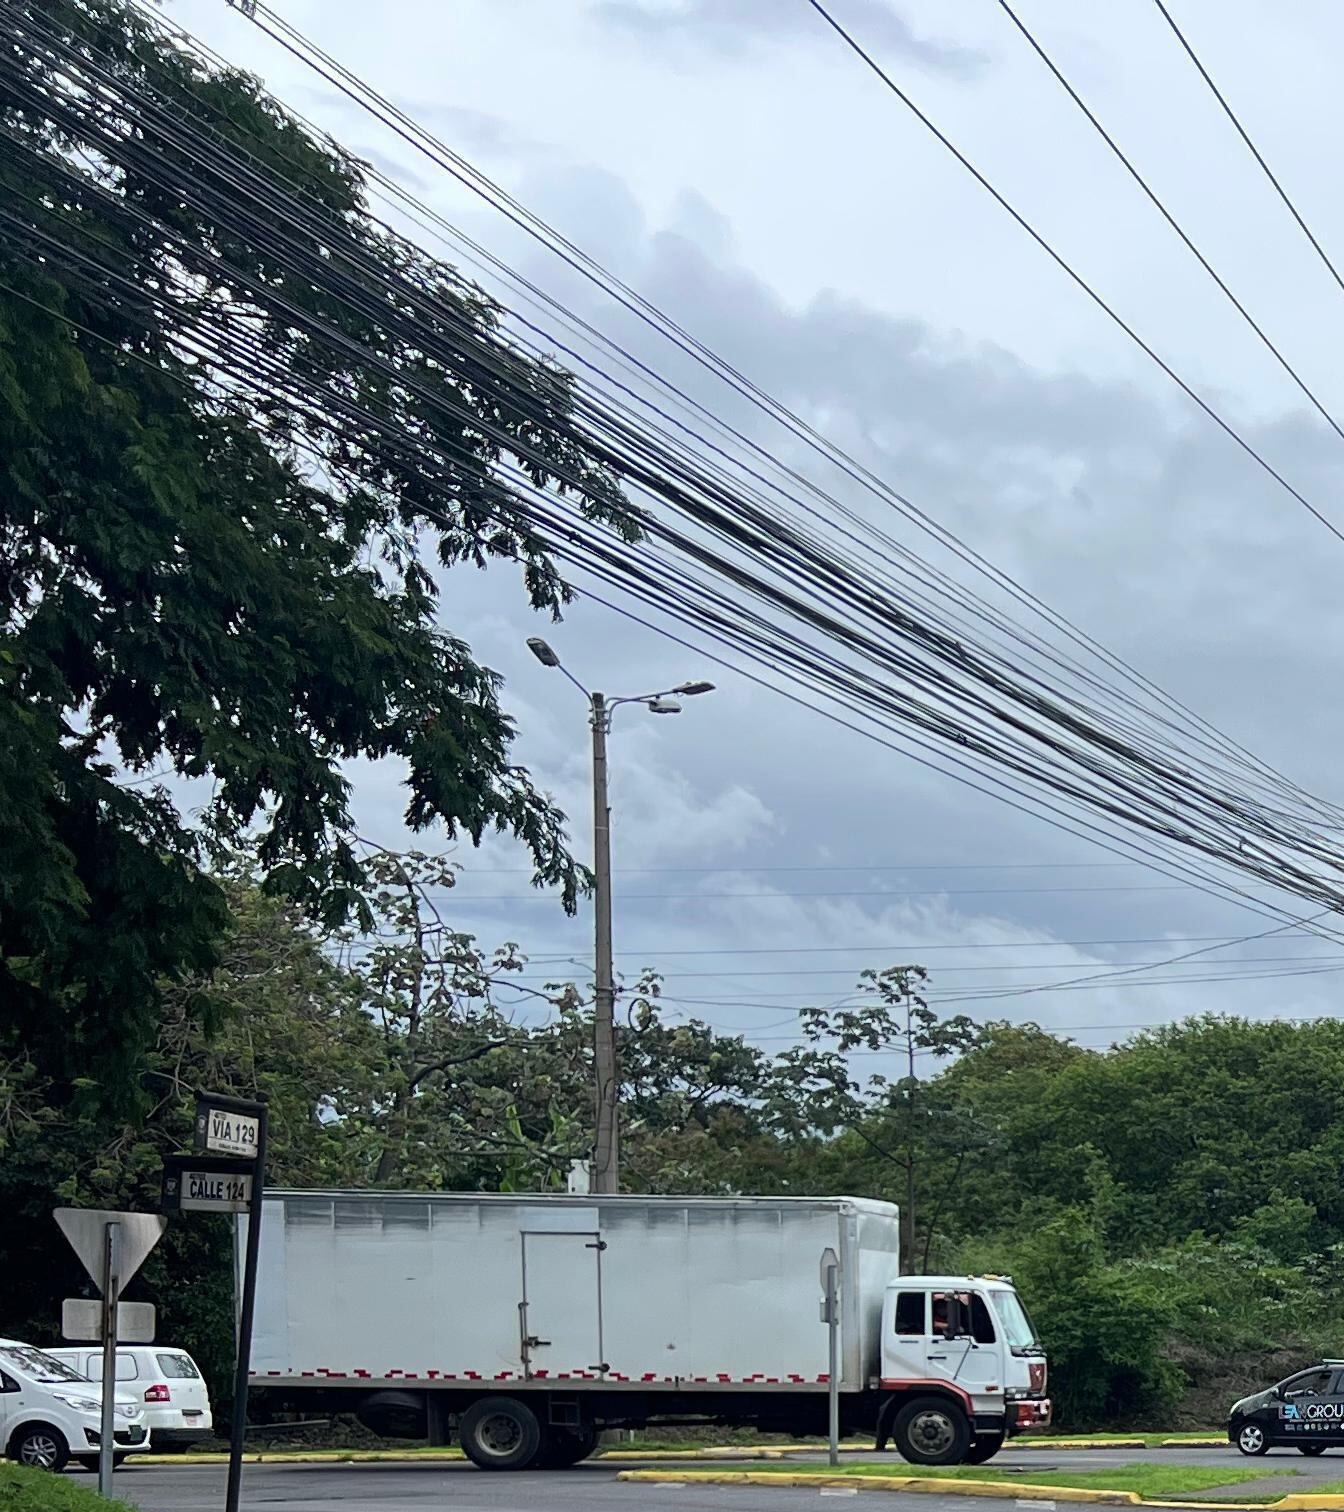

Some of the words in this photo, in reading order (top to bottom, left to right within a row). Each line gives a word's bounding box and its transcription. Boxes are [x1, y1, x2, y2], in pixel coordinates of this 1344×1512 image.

[236, 1123, 255, 1144] 129
[190, 1181, 224, 1199] CALLE
[226, 1182, 245, 1201] 124
